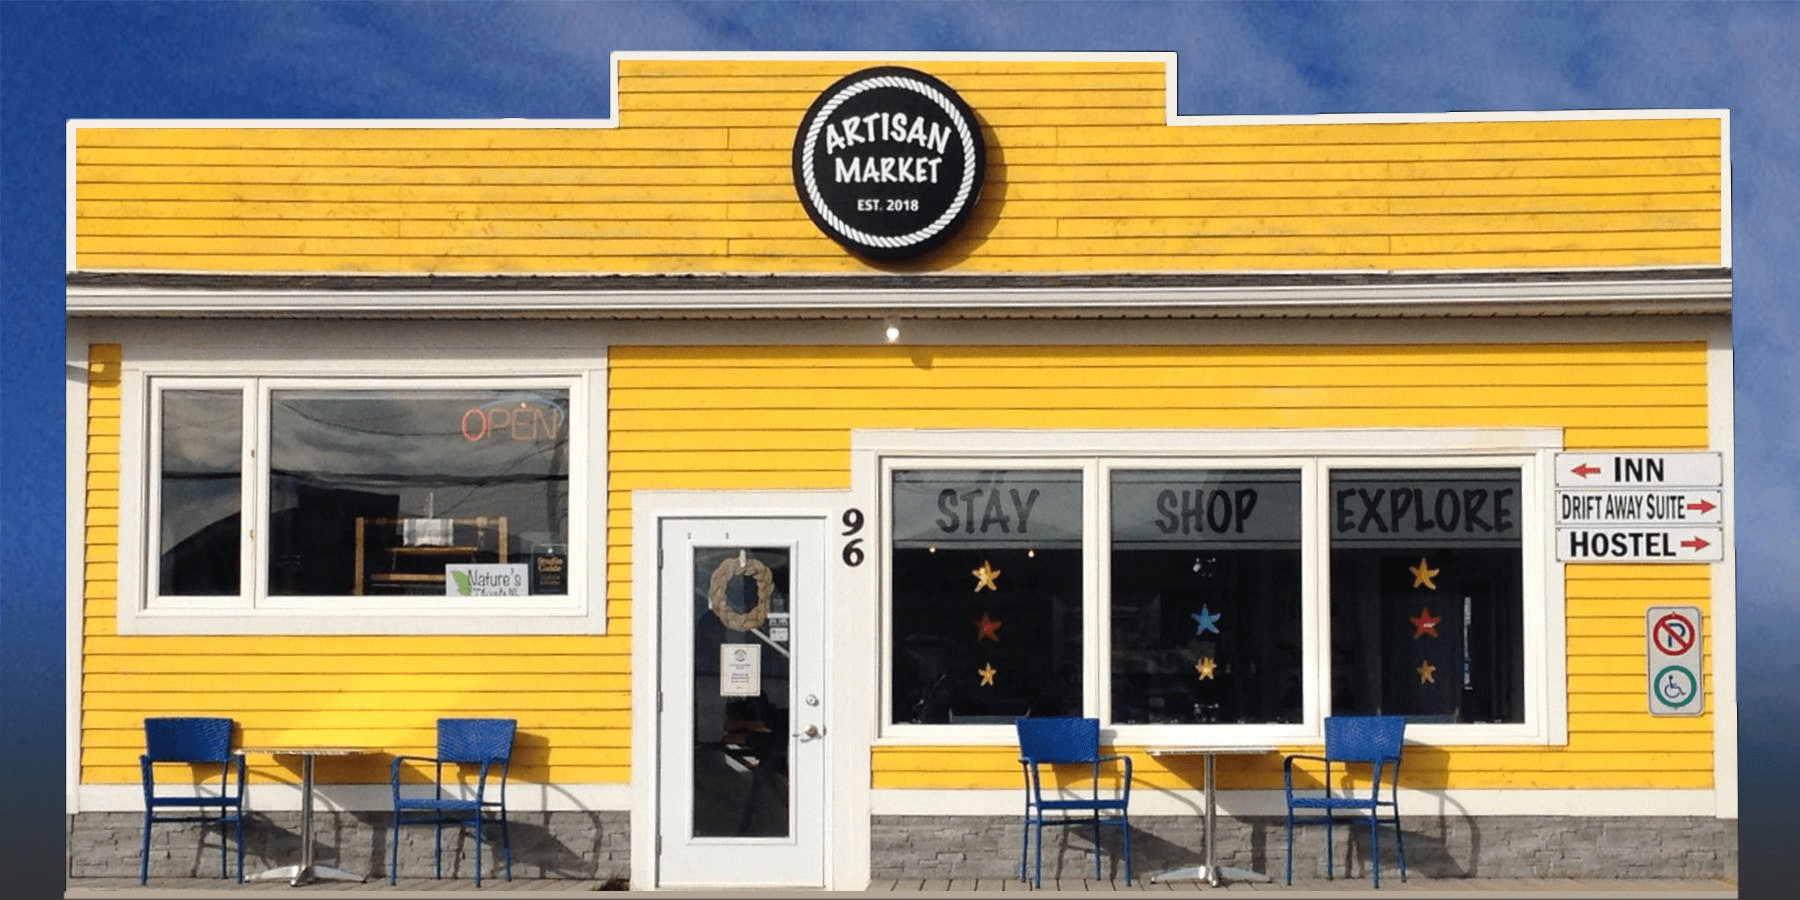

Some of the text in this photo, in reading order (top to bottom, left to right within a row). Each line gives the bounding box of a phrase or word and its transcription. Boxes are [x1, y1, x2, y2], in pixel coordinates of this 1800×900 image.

[826, 112, 952, 155] ARTISAN
[835, 156, 943, 184] MARKET
[857, 199, 920, 212] EST. 2018
[462, 408, 558, 441] OPEN
[1614, 456, 1665, 483] INN
[936, 488, 1041, 534] STAY
[1155, 488, 1259, 535] SHOP
[1336, 487, 1514, 534] EXPLORE
[1562, 493, 1686, 520] DRIFT AWAY SUITE
[1570, 531, 1677, 558] HOSTEL
[467, 568, 522, 587] Nature's
